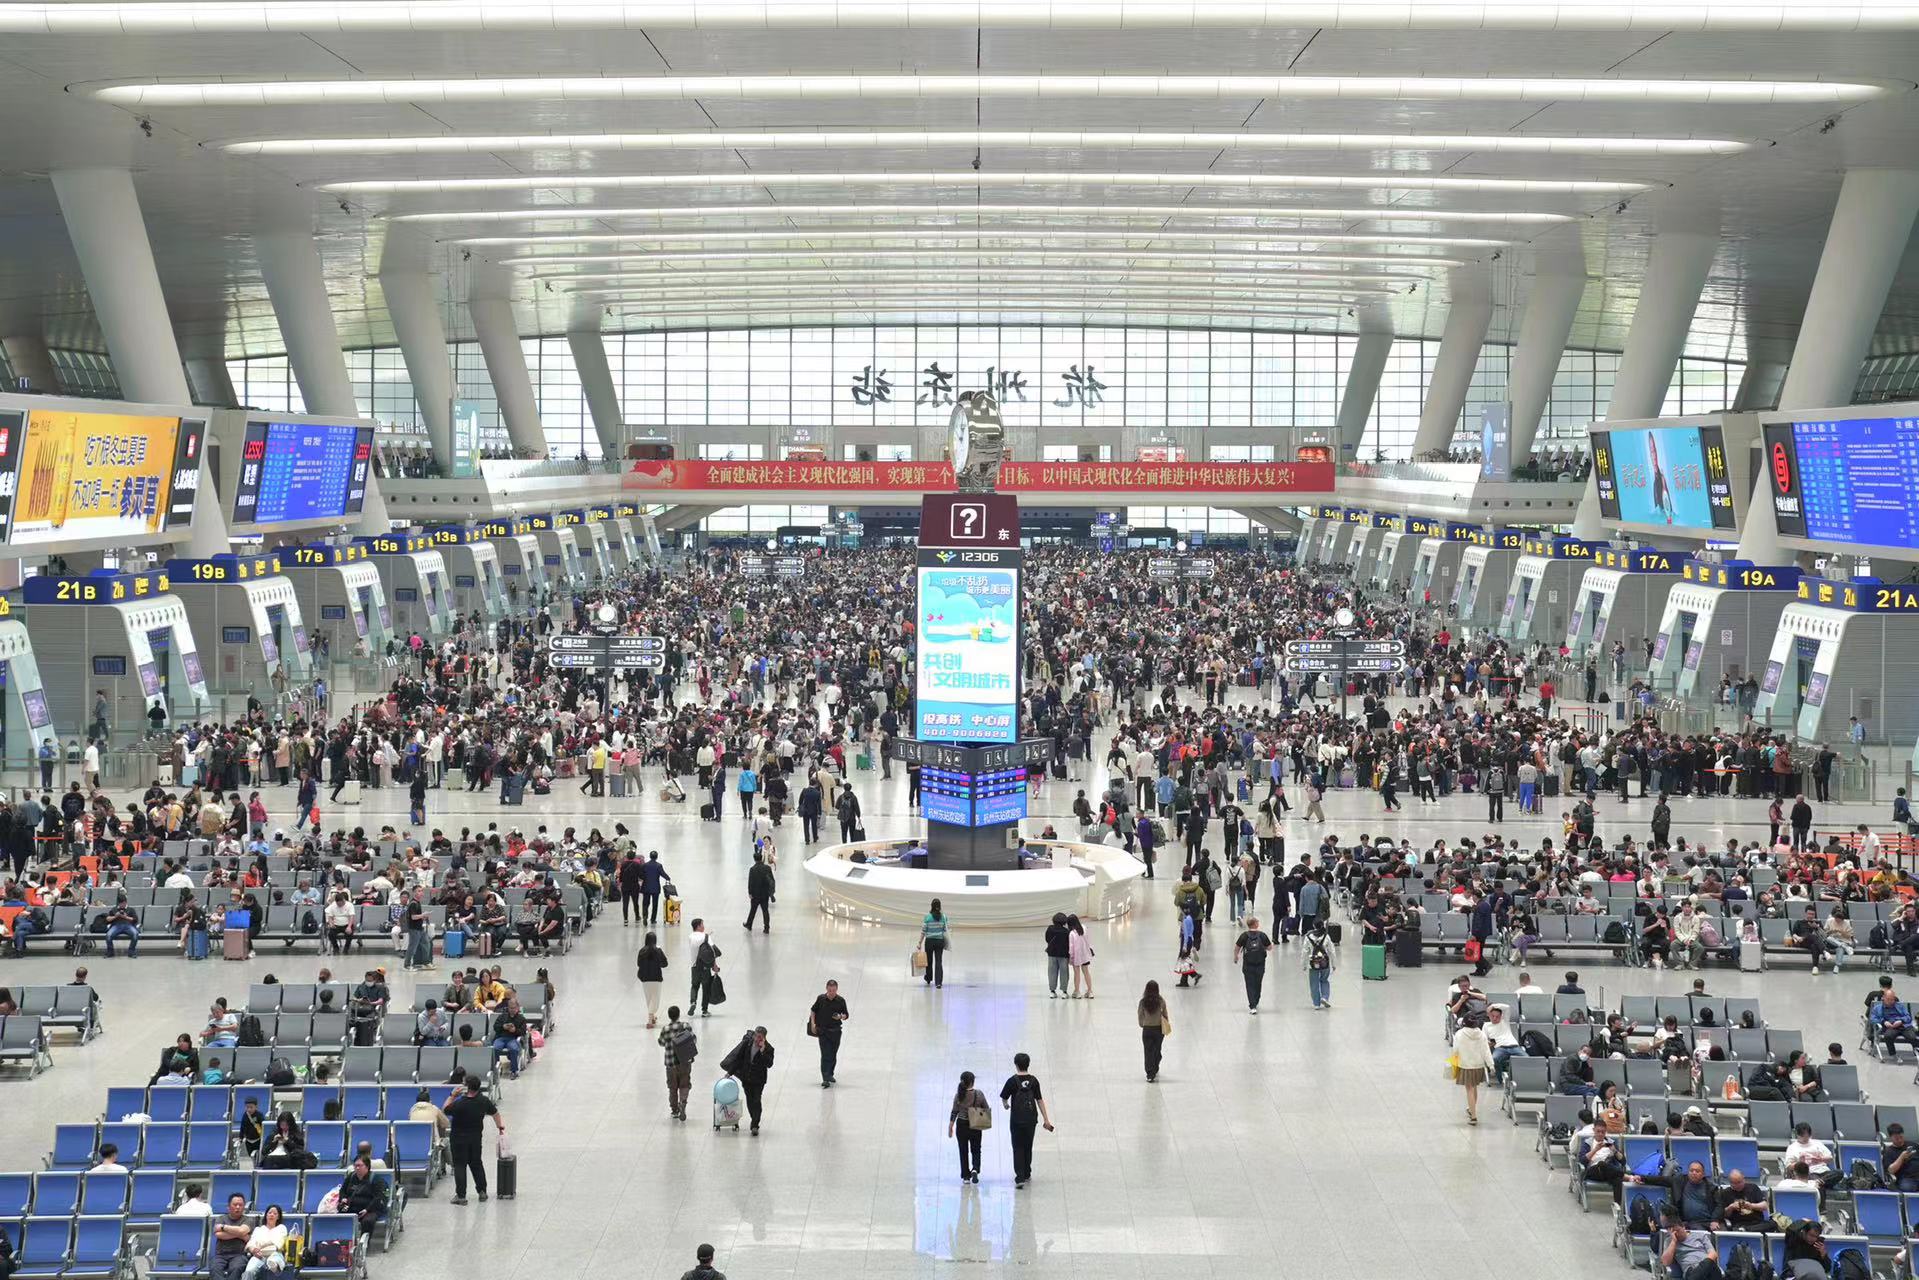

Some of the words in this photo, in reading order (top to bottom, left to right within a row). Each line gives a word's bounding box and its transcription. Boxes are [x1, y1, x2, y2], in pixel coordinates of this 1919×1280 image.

[707, 466, 1295, 486] 全面建成社会主义现代化强国，实现第二个目标，以中国式现代化全面推进中华民族伟大复兴！
[1412, 522, 1425, 532] 9A
[435, 531, 457, 542] 13B
[998, 529, 1010, 541] 东
[373, 540, 398, 552] 15B
[1563, 544, 1588, 556] 15A
[295, 549, 324, 563] 17B
[961, 552, 999, 562] 12306
[1639, 556, 1670, 569] 17A
[192, 564, 225, 579] 19B
[1741, 570, 1775, 586] 19A
[57, 581, 96, 600] 21B
[1876, 590, 1918, 608] 21A
[924, 653, 963, 670] 共创
[933, 672, 1010, 689] 文明城市
